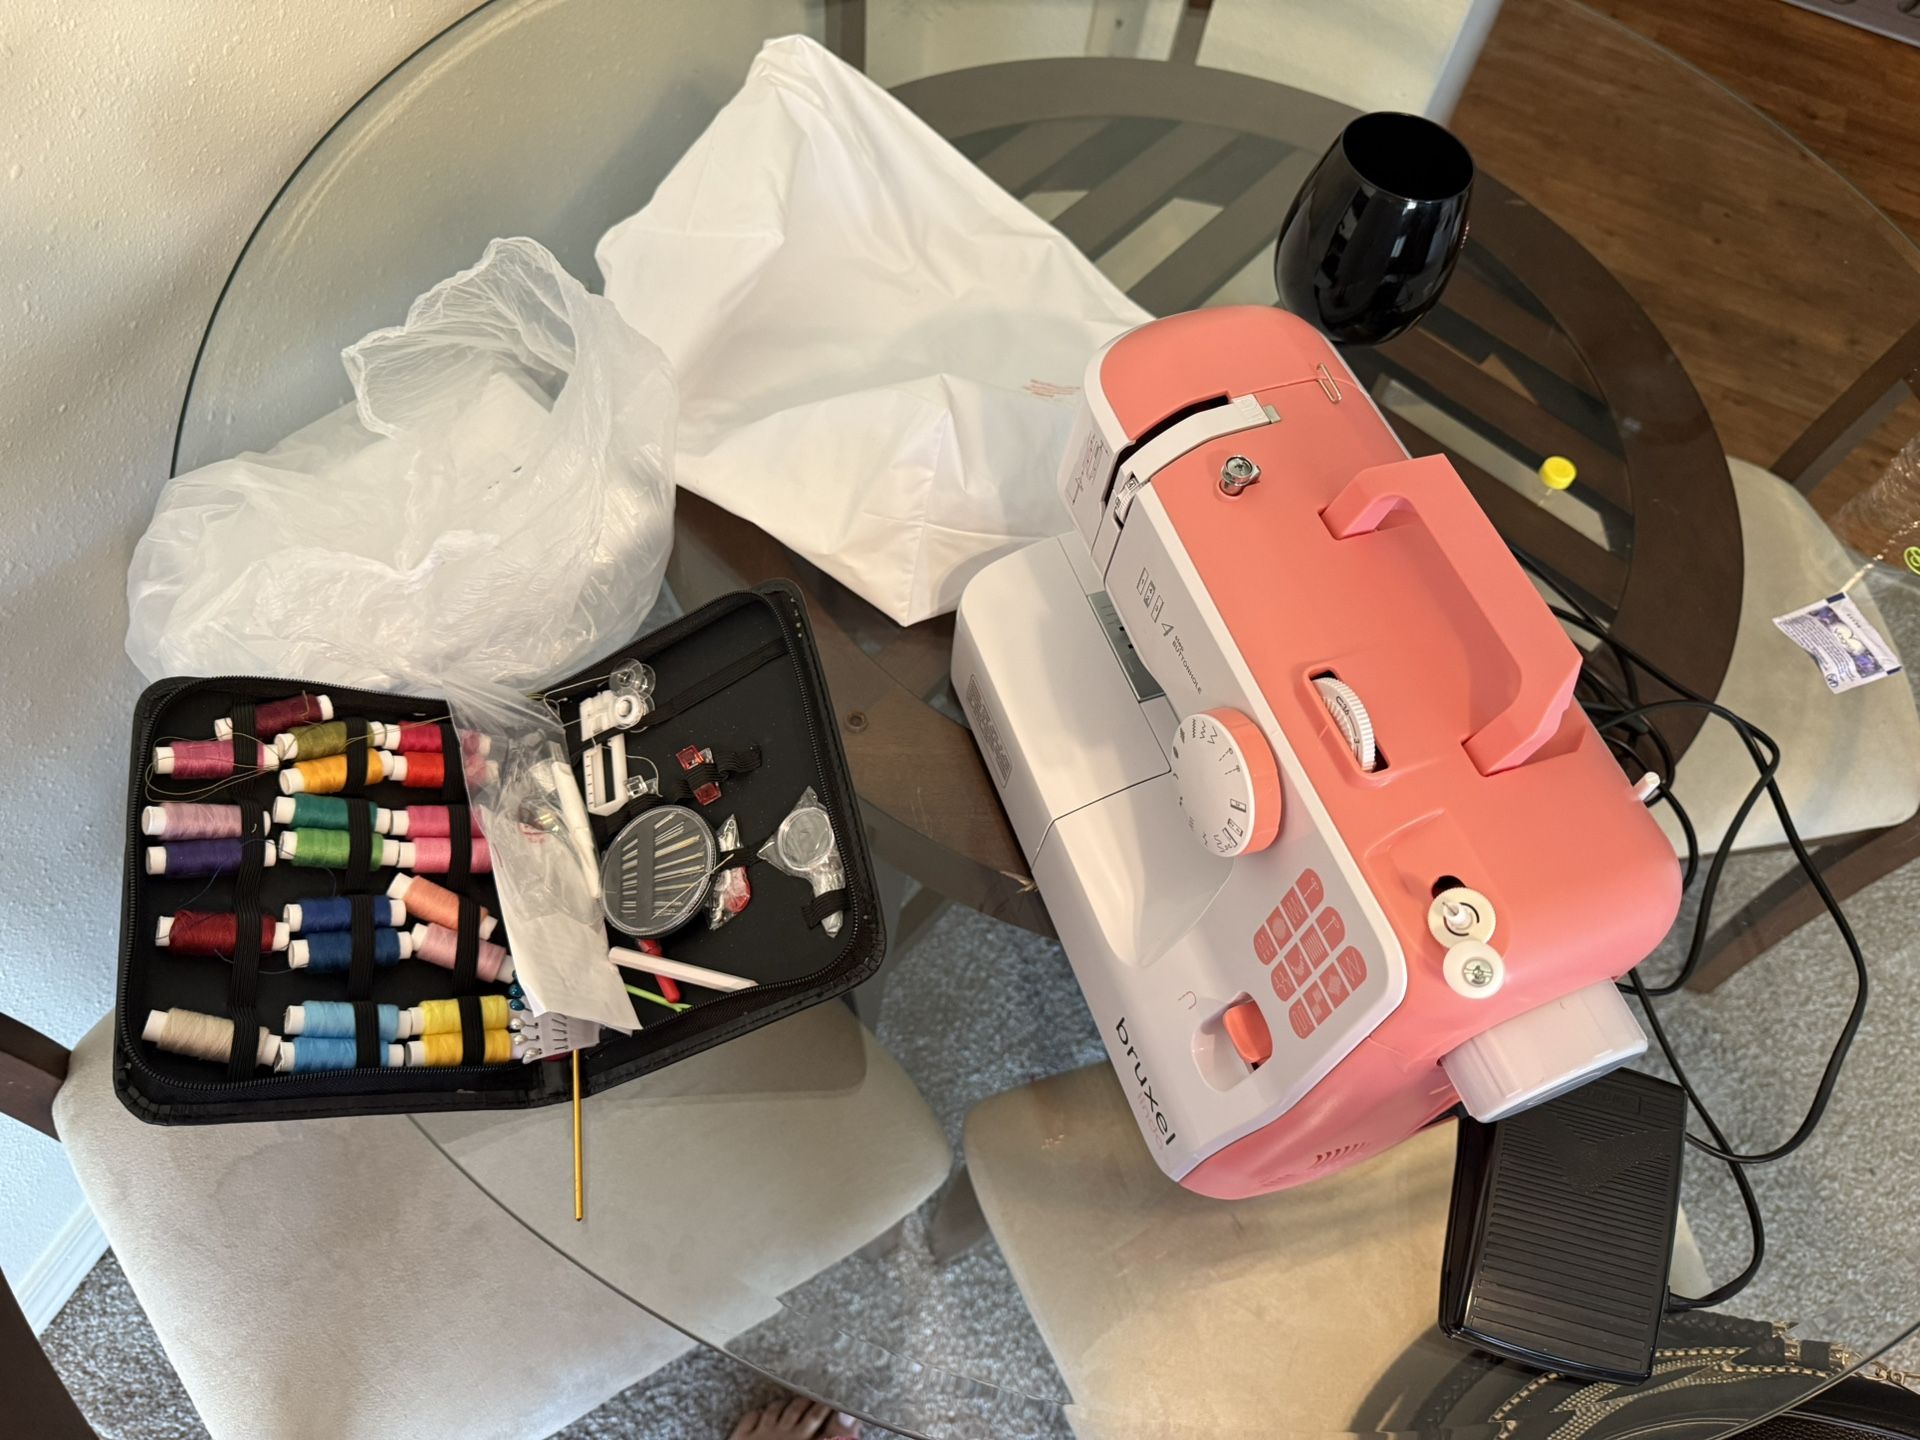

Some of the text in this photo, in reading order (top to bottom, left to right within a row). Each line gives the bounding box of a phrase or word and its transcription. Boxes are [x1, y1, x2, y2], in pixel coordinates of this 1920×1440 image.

[1161, 622, 1175, 637] 4
[1172, 640, 1202, 695] BUTTONHOLE
[1116, 1017, 1176, 1145] bruxel
